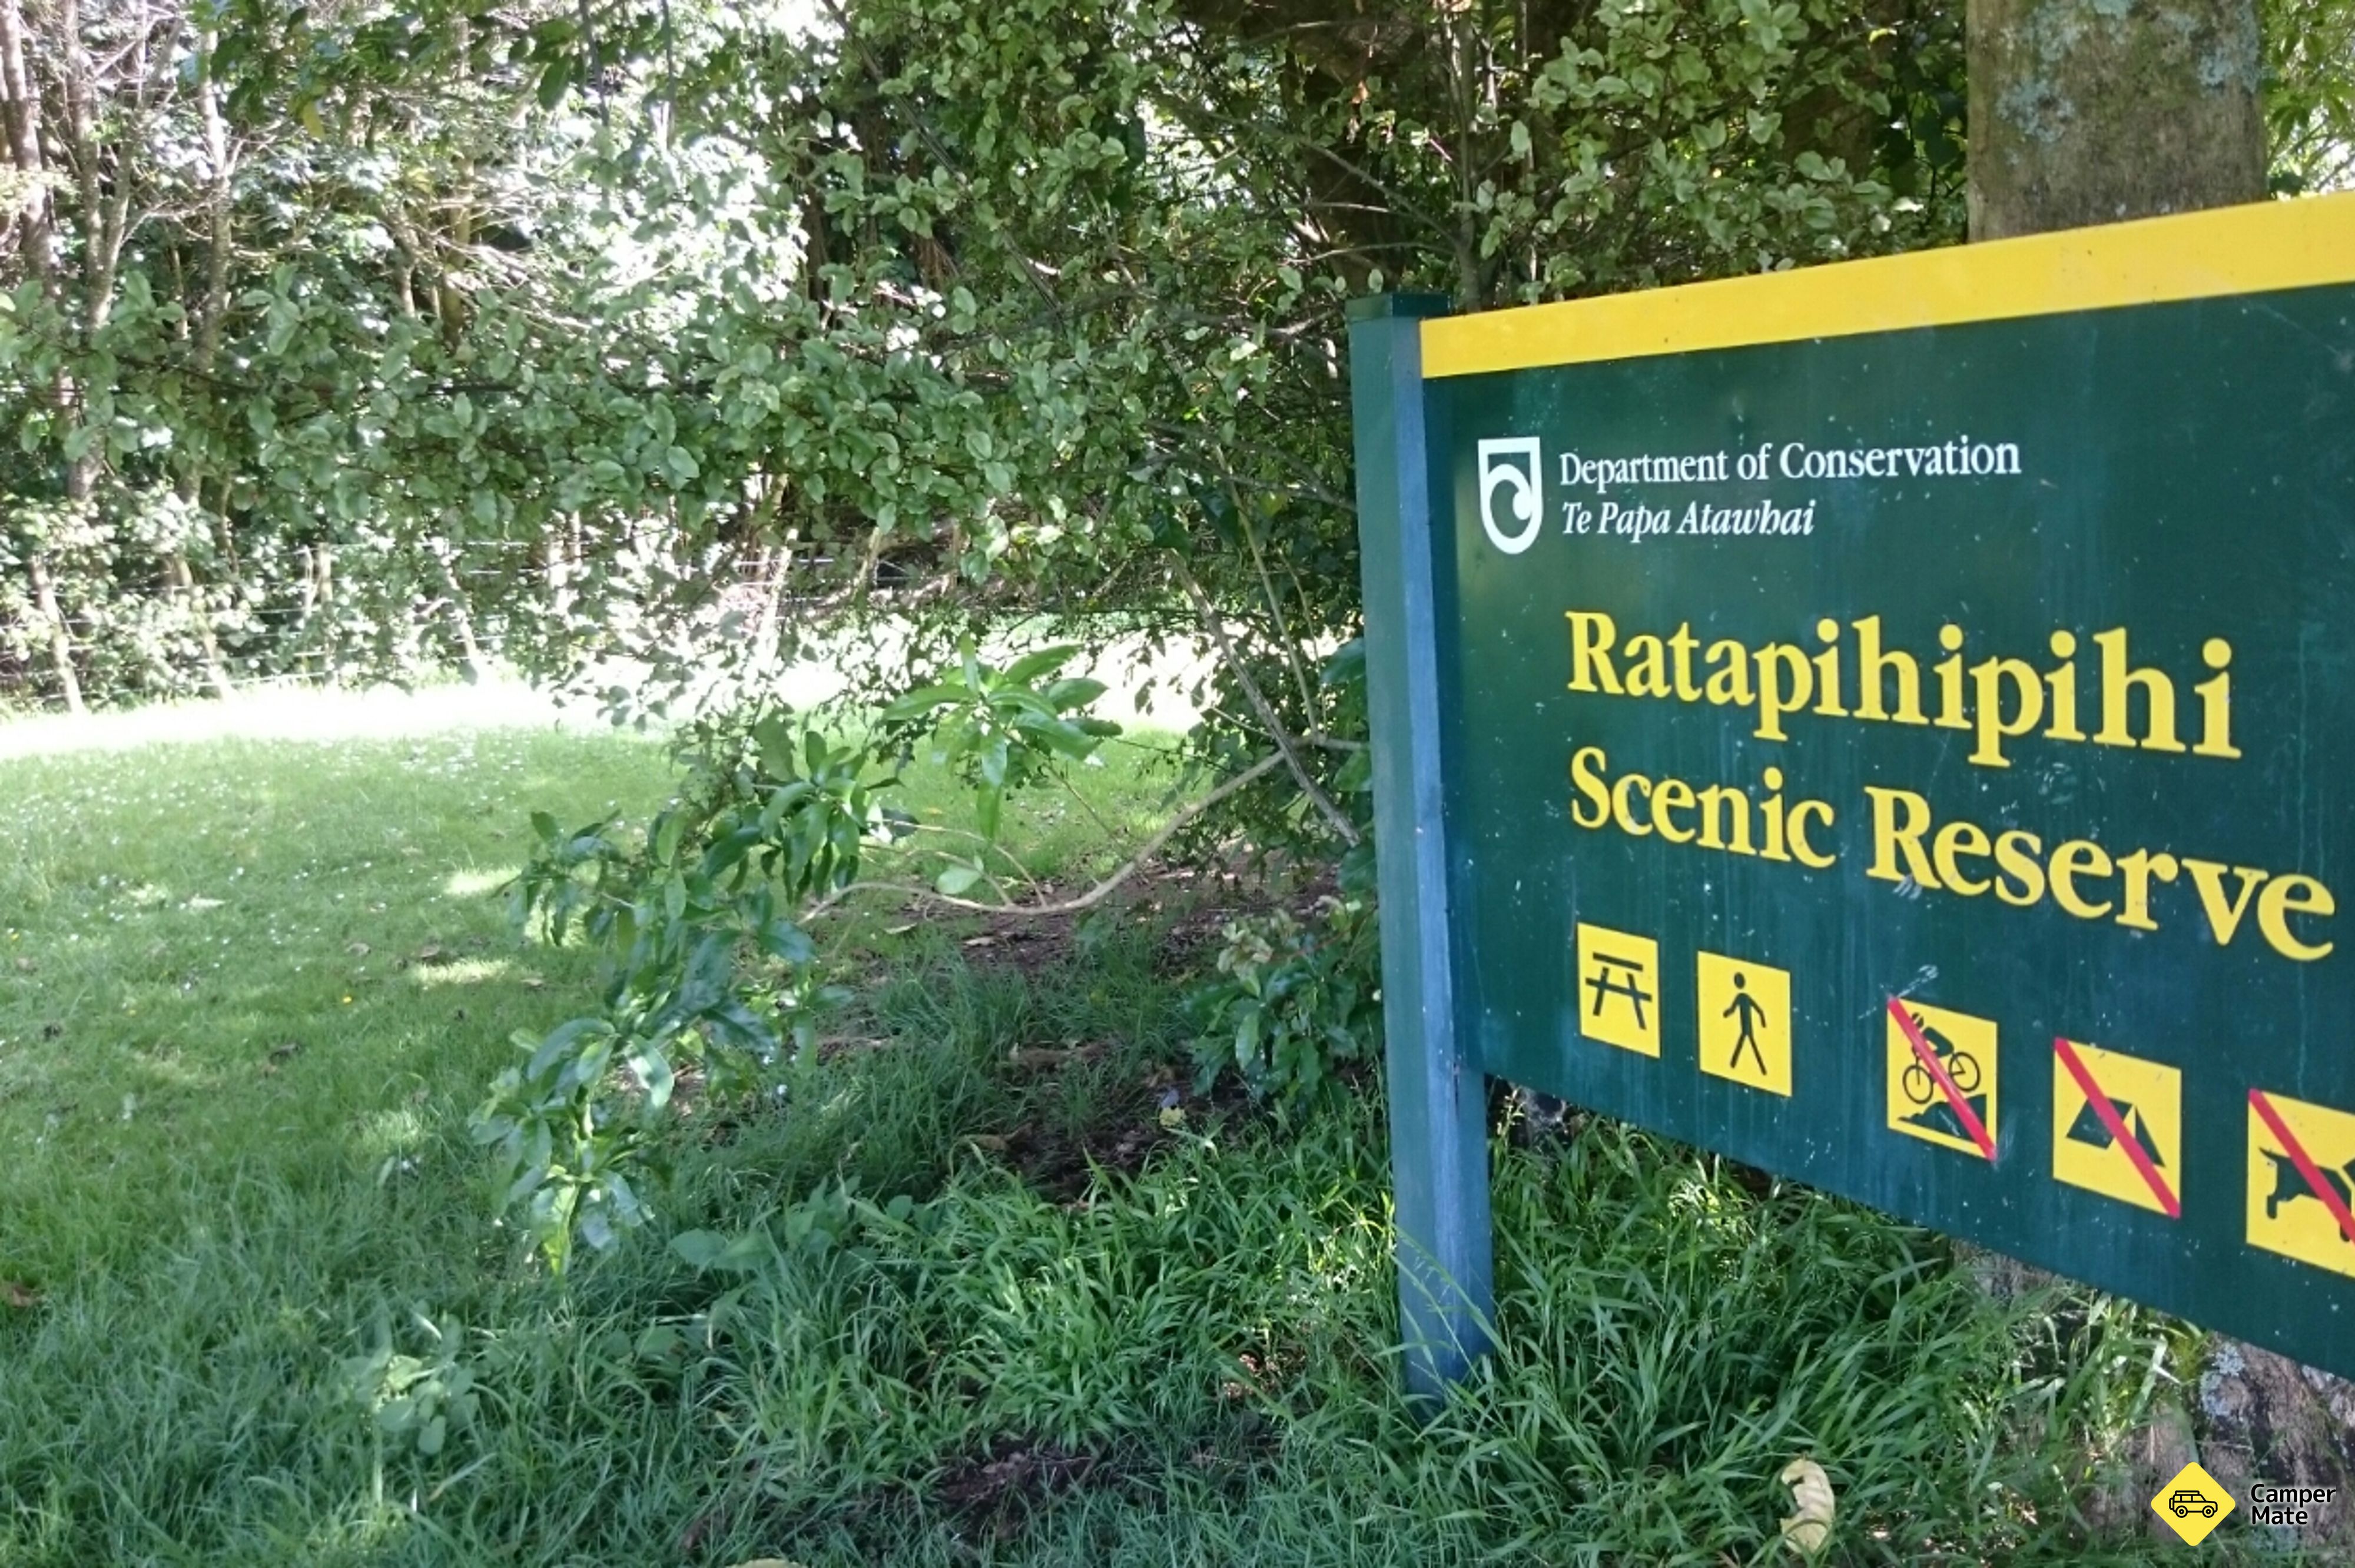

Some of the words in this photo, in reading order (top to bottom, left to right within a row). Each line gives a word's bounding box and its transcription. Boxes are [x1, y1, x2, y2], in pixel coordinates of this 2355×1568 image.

[1559, 449, 1729, 493] Department
[1737, 443, 1772, 480] of
[1780, 434, 2021, 479] Conservation
[1562, 501, 1591, 535] Te
[1597, 501, 1671, 543] Papa
[1677, 500, 1816, 536] Atawhai
[1565, 610, 2241, 767] Ratapihipihi
[1571, 746, 1836, 868] Scenic
[1865, 786, 2336, 961] Reserve
